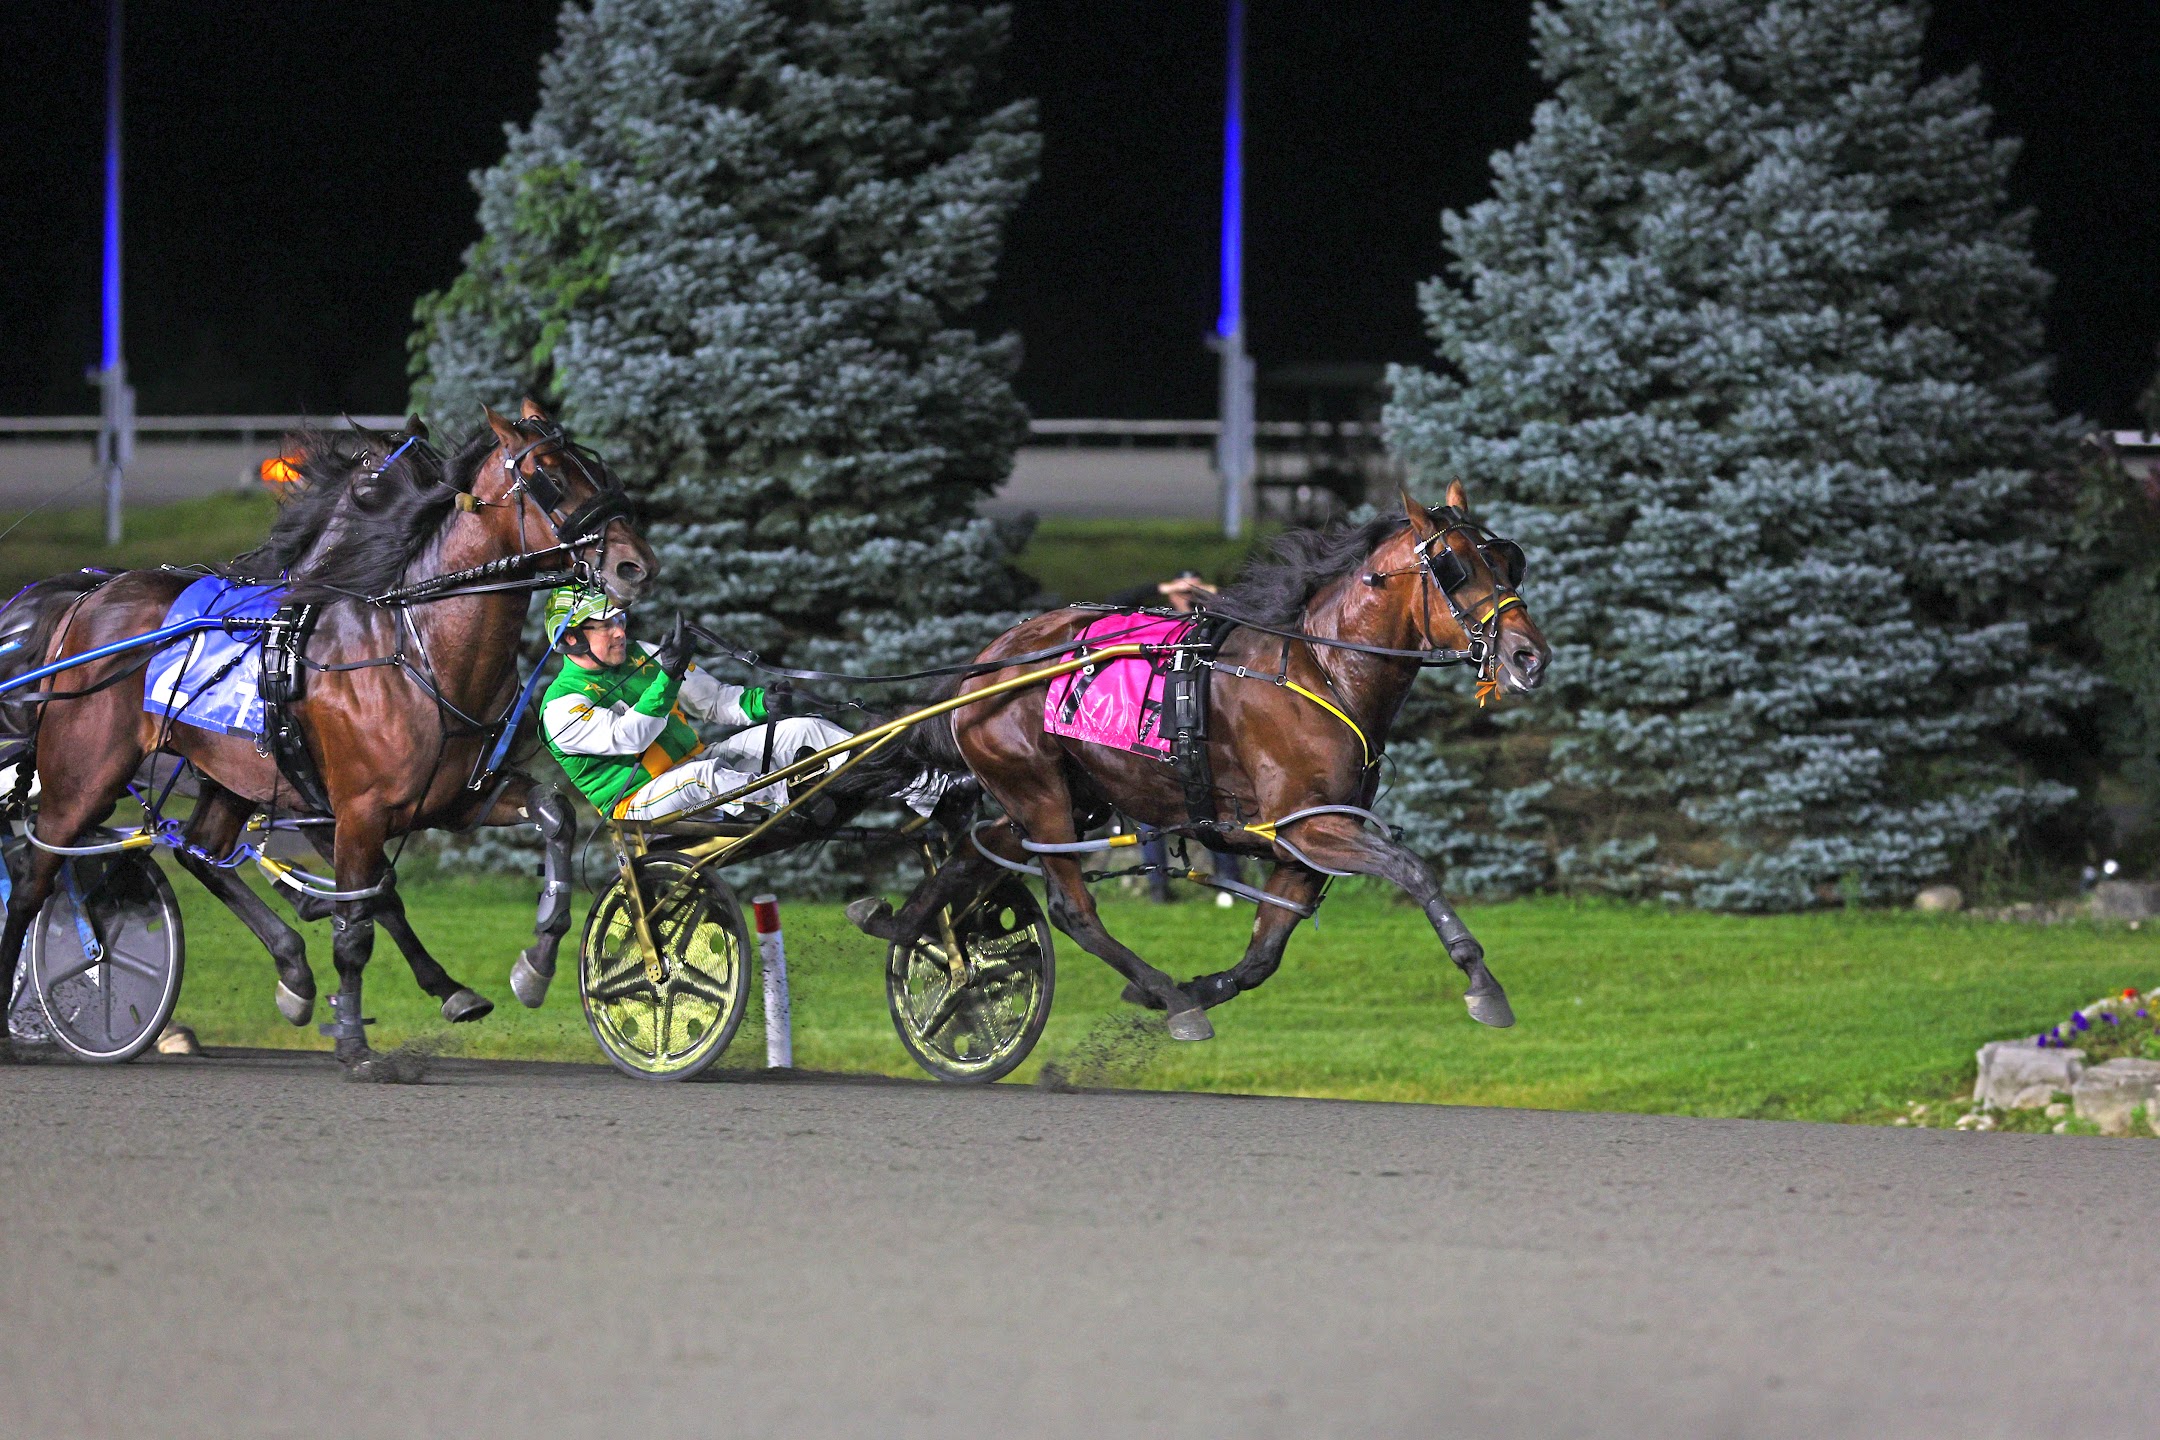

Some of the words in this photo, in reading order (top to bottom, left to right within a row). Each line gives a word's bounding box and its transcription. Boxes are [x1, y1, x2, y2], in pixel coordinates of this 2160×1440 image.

[150, 629, 206, 710] 2
[234, 680, 257, 729] 7
[1060, 643, 1116, 725] 7
